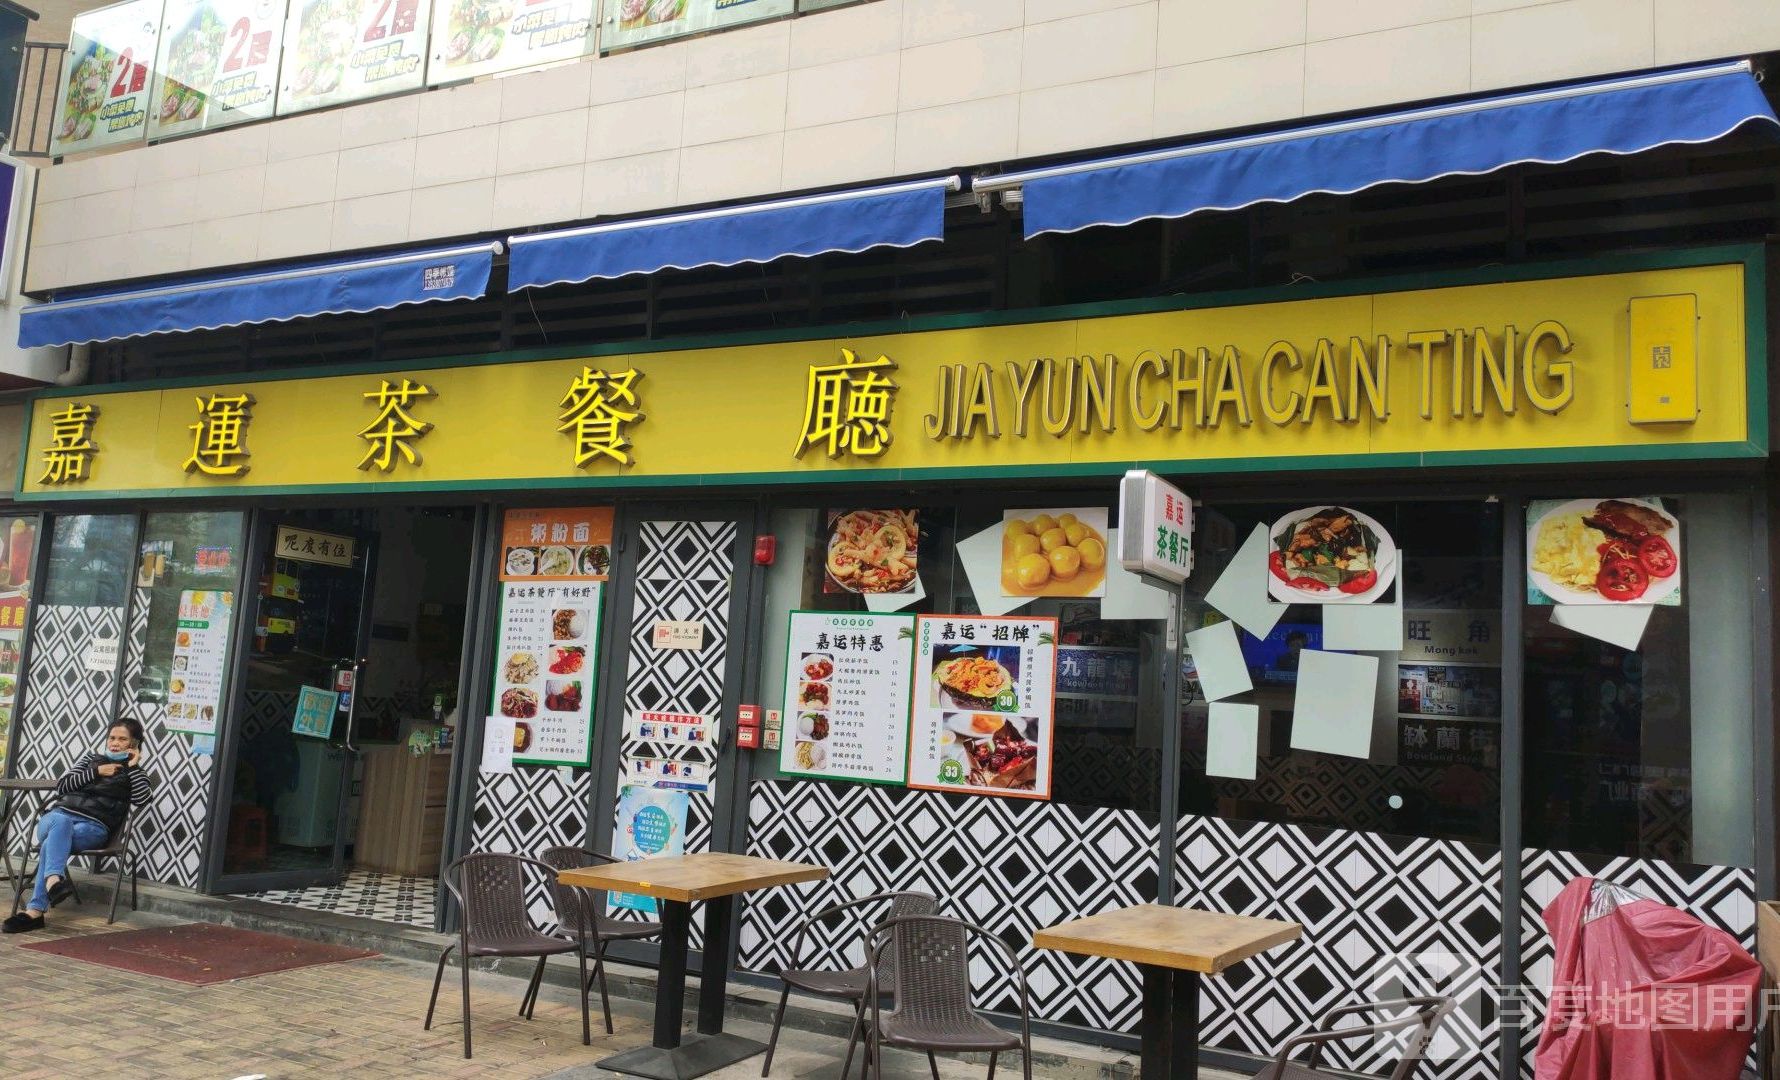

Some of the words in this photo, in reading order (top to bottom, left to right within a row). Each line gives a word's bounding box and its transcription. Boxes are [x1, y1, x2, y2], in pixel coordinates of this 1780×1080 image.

[924, 362, 1001, 441] JIA
[1005, 354, 1116, 438] YUN
[1130, 345, 1251, 432] CHA
[1260, 336, 1389, 427] CAN
[1407, 320, 1575, 416] TING
[38, 347, 899, 485] 嘉運茶餐廳
[1165, 493, 1184, 526] 嘉运
[284, 533, 347, 559] 呢度有位
[1157, 524, 1189, 568] 茶餐厅
[815, 632, 884, 652] 嘉运特惠
[1407, 619, 1491, 642] 旺角
[1424, 645, 1456, 657] Mong
[1000, 696, 1013, 707] 30
[944, 766, 958, 777] 33
